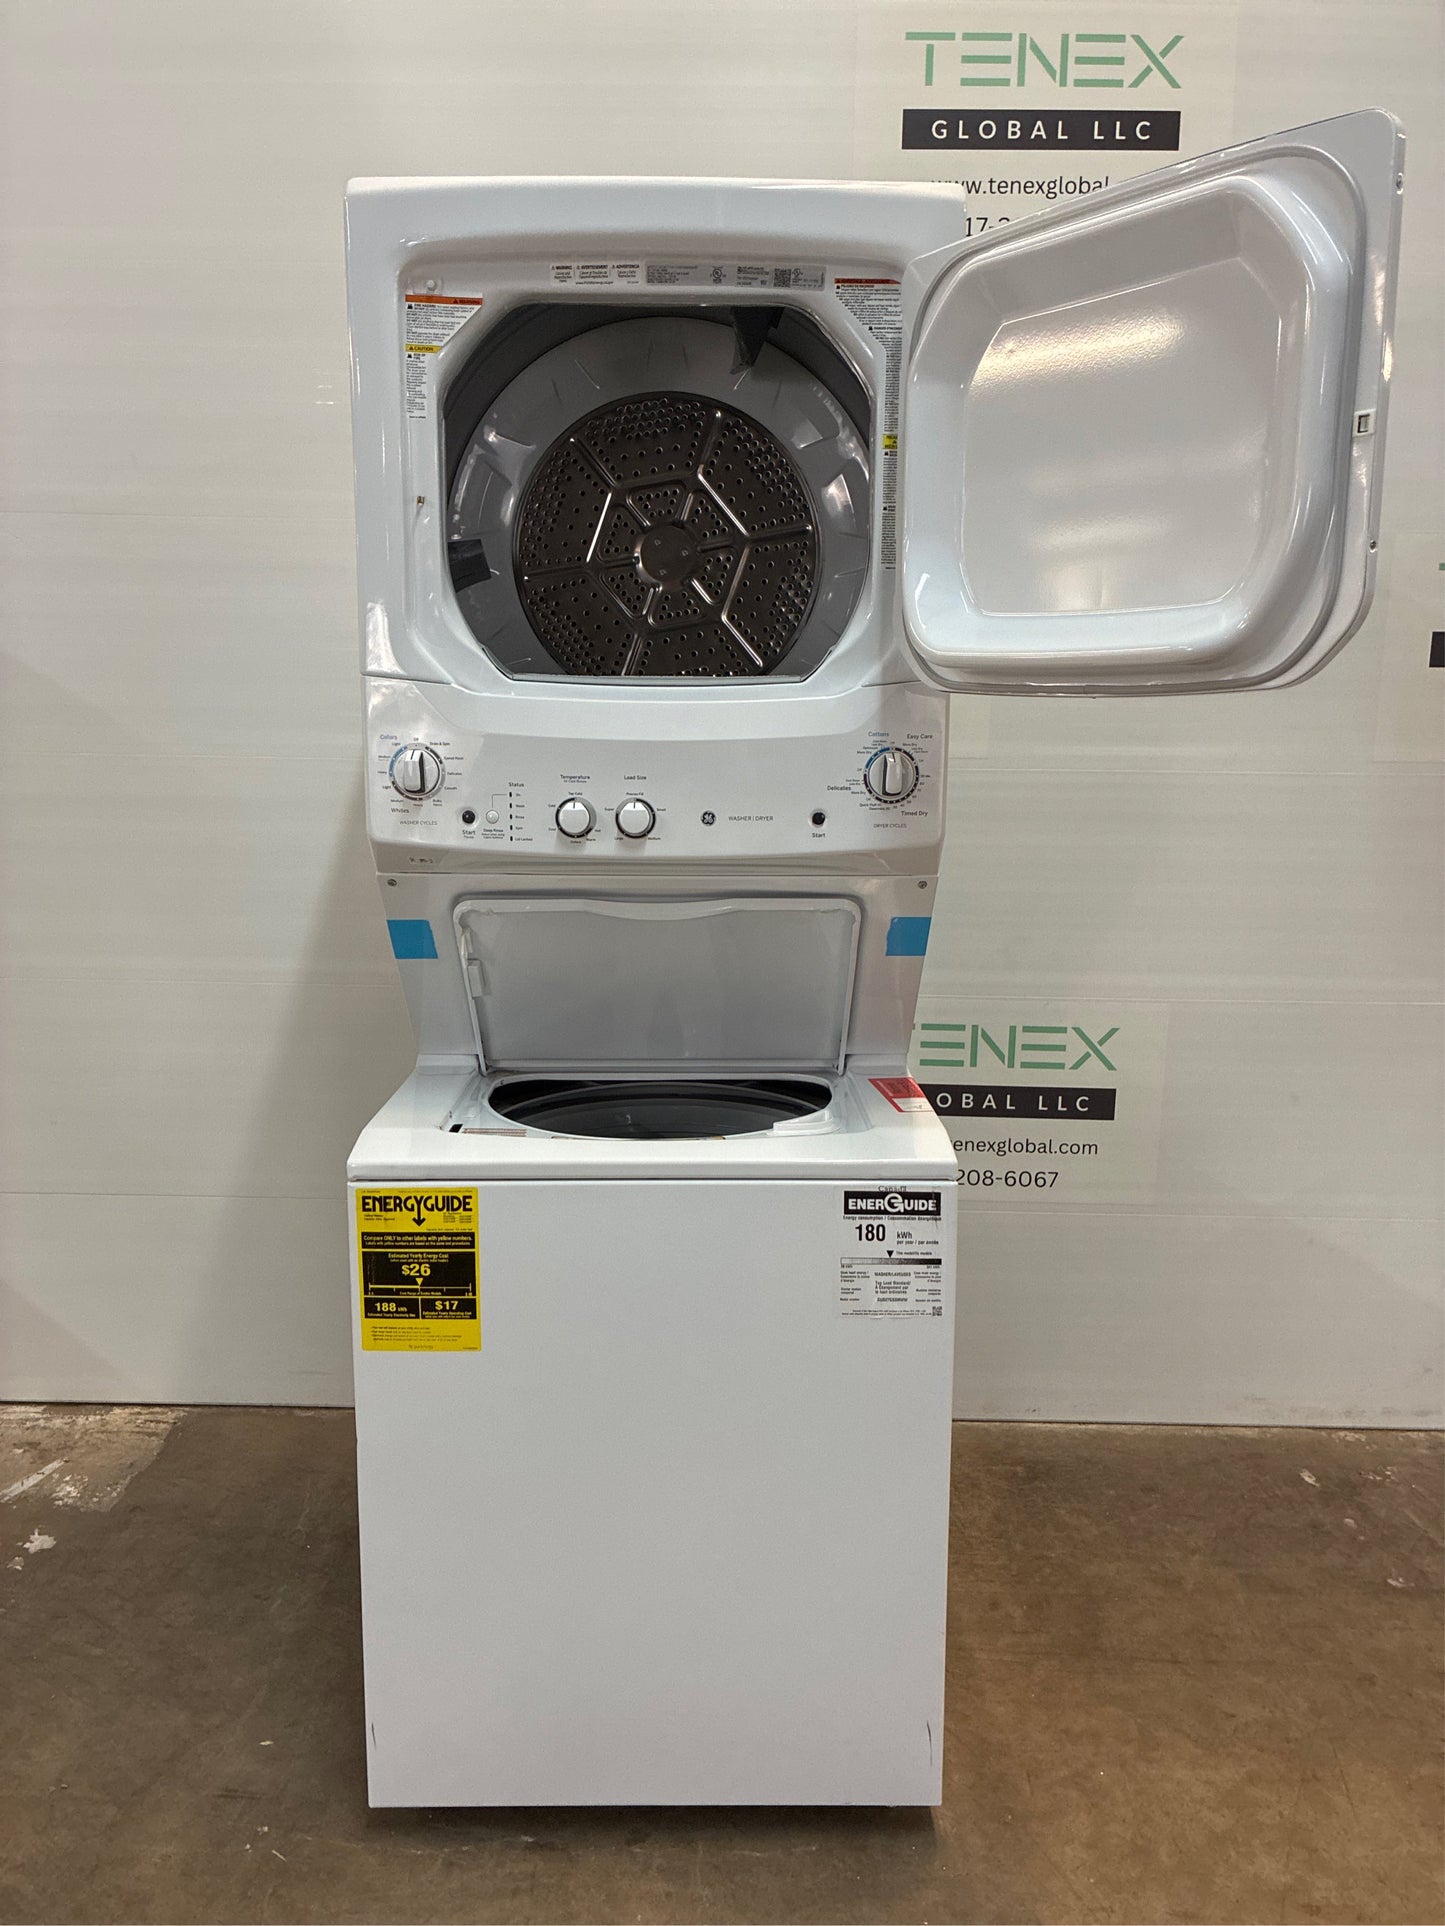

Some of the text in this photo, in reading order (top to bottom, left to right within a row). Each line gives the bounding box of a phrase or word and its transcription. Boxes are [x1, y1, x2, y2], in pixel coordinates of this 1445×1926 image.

[905, 32, 1184, 88] TENEX
[932, 119, 1152, 141] GLOBAL LLC
[912, 1023, 1120, 1071] ENEX
[1039, 1095, 1090, 1112] LLC
[951, 1138, 1098, 1157] enexglobal.com
[362, 1195, 473, 1212] ENERGYGUIDE
[848, 1193, 937, 1213] ENERGUIDE
[855, 1224, 886, 1242] 180
[402, 1264, 431, 1276] $26
[374, 1302, 396, 1312] 188
[435, 1300, 458, 1310] $17
